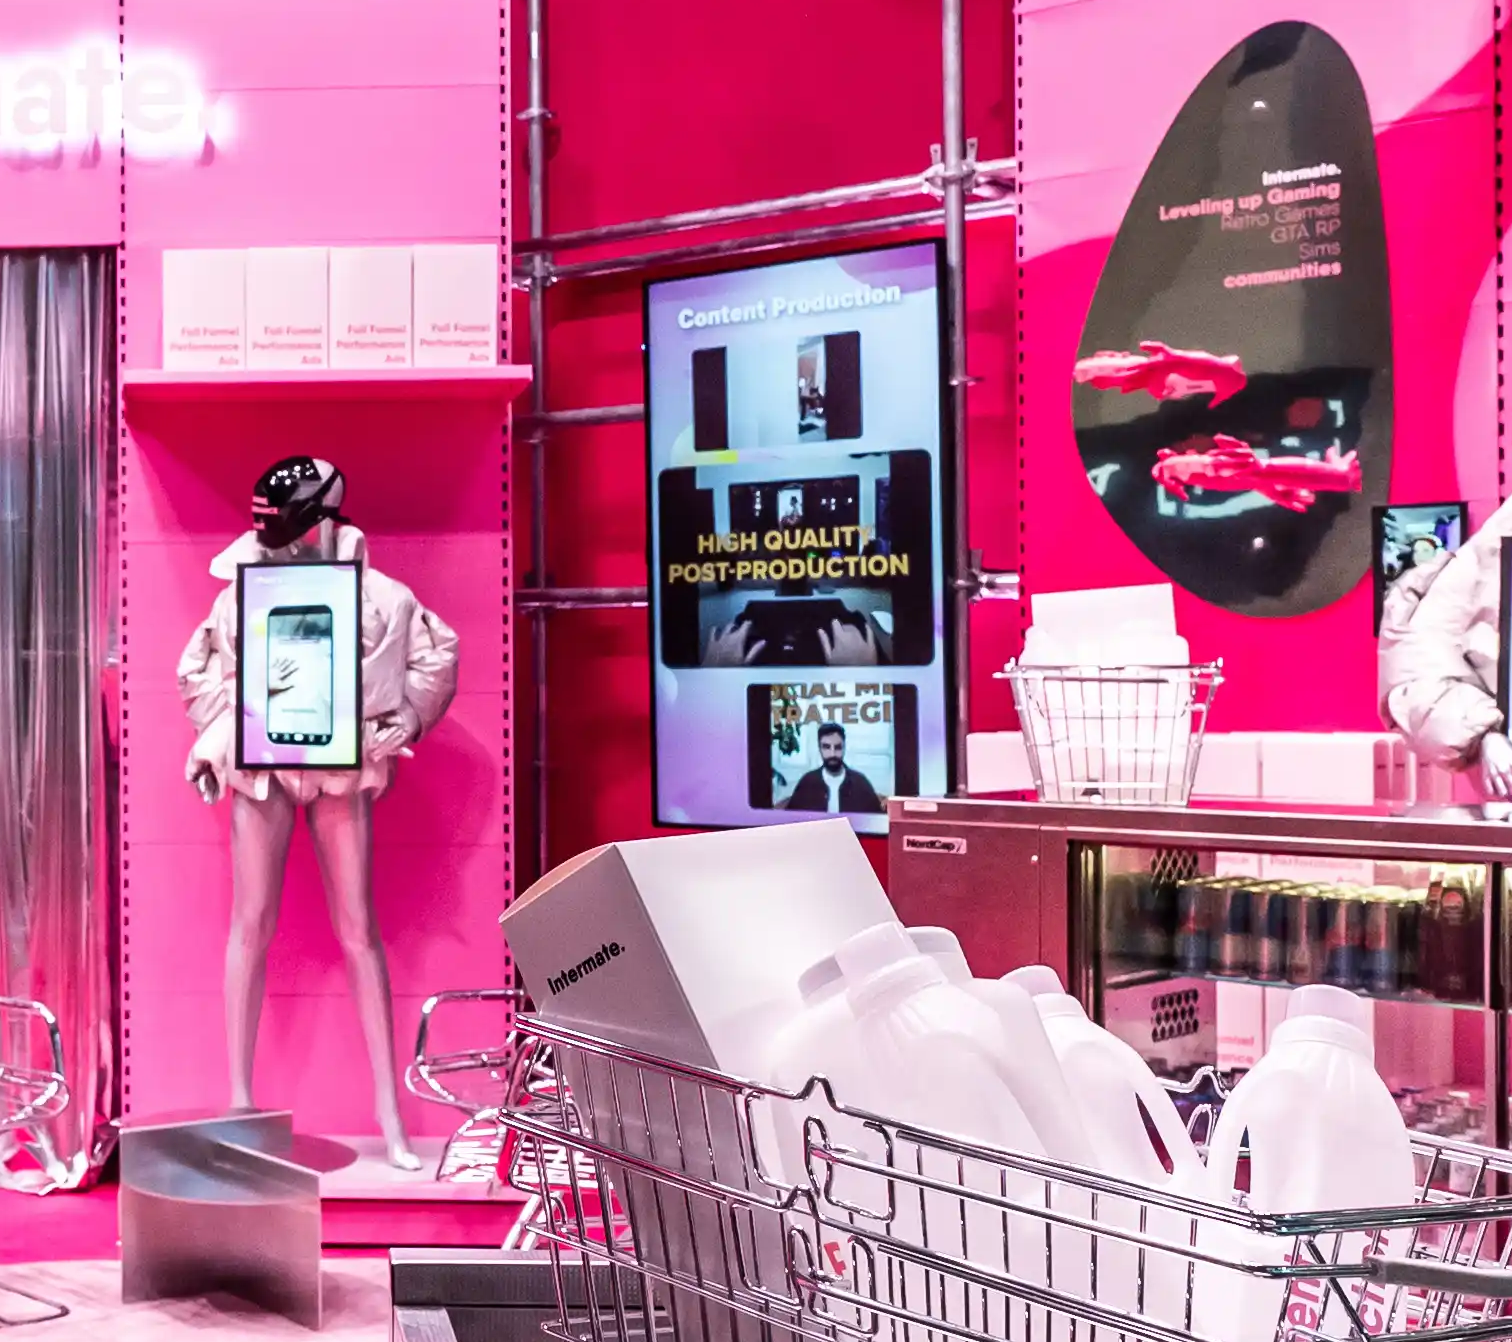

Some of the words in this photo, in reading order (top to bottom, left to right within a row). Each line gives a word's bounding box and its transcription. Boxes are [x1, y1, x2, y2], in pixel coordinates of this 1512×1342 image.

[1160, 196, 1235, 221] Leveling
[1237, 193, 1264, 211] up
[1267, 182, 1341, 205] Gaming
[1221, 212, 1270, 231] Retro
[1275, 202, 1341, 224] Games
[1270, 226, 1310, 244] GTA
[1316, 219, 1342, 237] RP
[1299, 241, 1341, 260] Sims
[1223, 261, 1342, 288] communities
[678, 303, 766, 330] Content
[771, 285, 901, 317] Production
[697, 532, 757, 554] HIGH
[764, 525, 872, 551] QUALITY
[668, 553, 911, 584] POST-PRODUCTION
[546, 942, 625, 996] Intermate.
